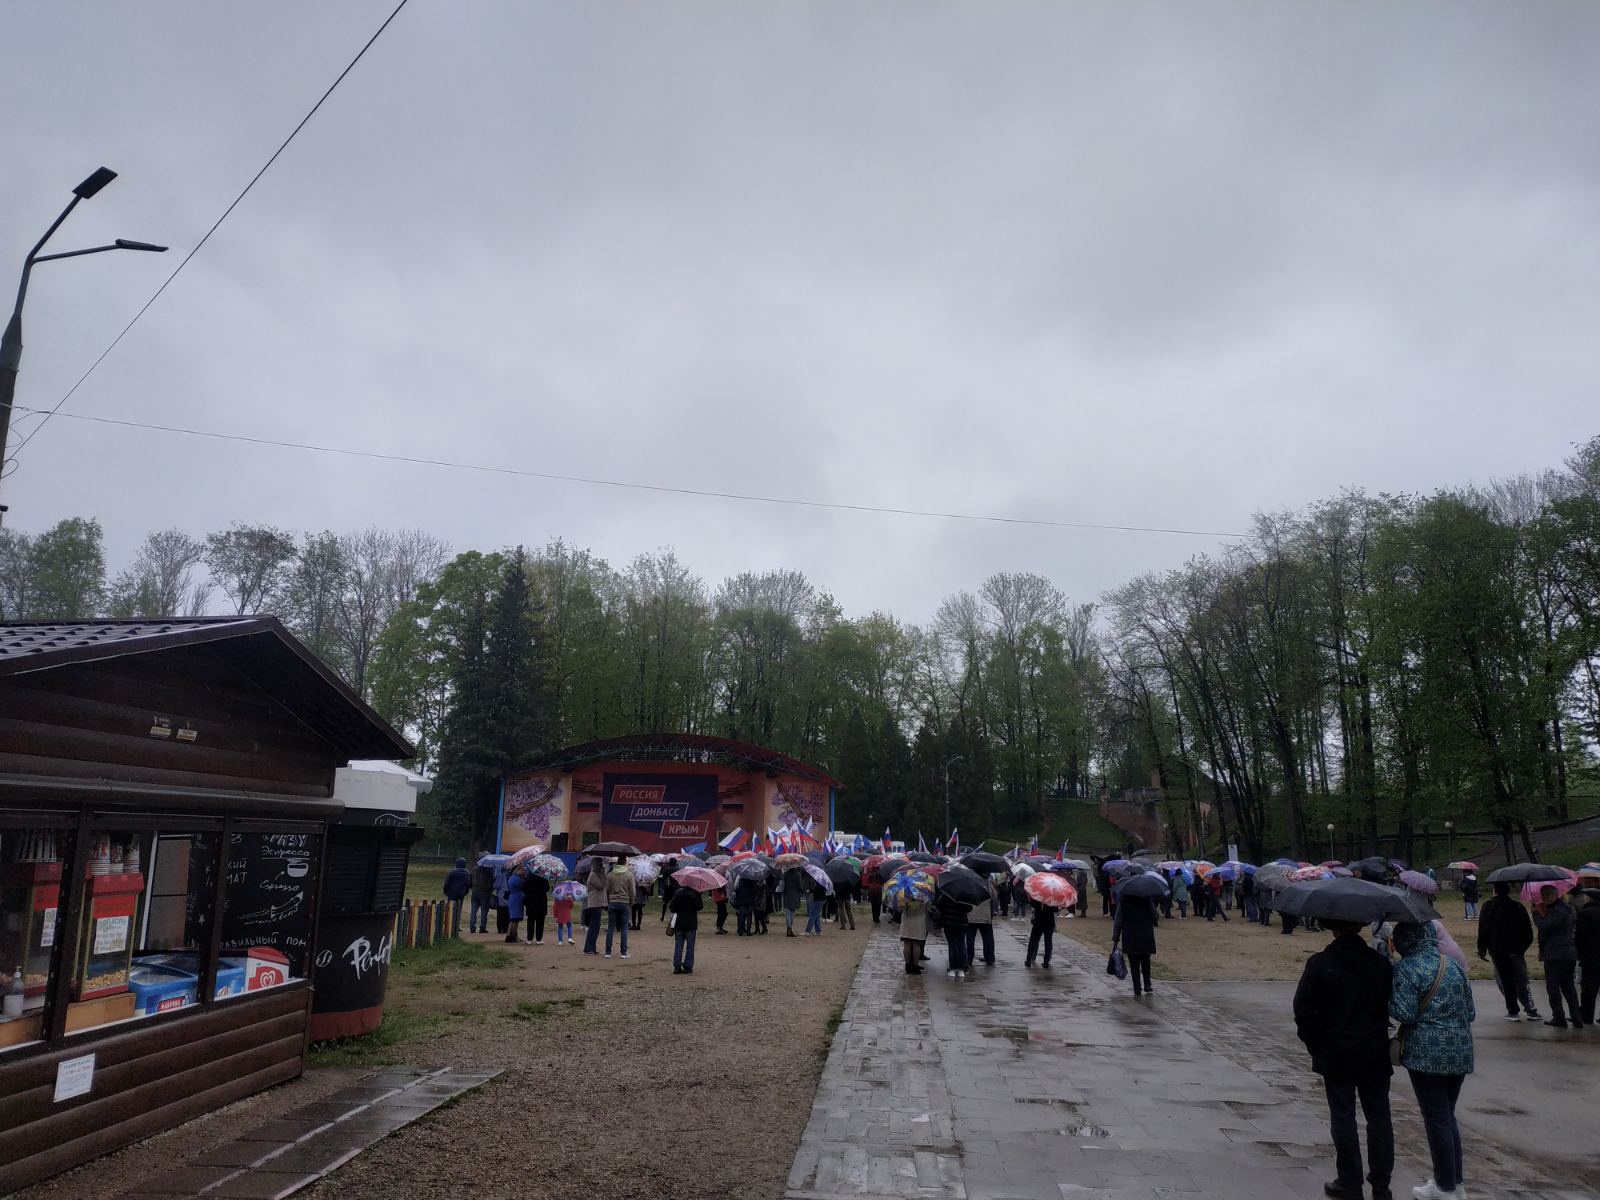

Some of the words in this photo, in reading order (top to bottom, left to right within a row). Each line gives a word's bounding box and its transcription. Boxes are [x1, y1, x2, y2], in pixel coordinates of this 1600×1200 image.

[619, 789, 658, 799] РОССИЯ
[635, 807, 681, 817] ДОНБАСС
[668, 824, 699, 834] КРЫМ
